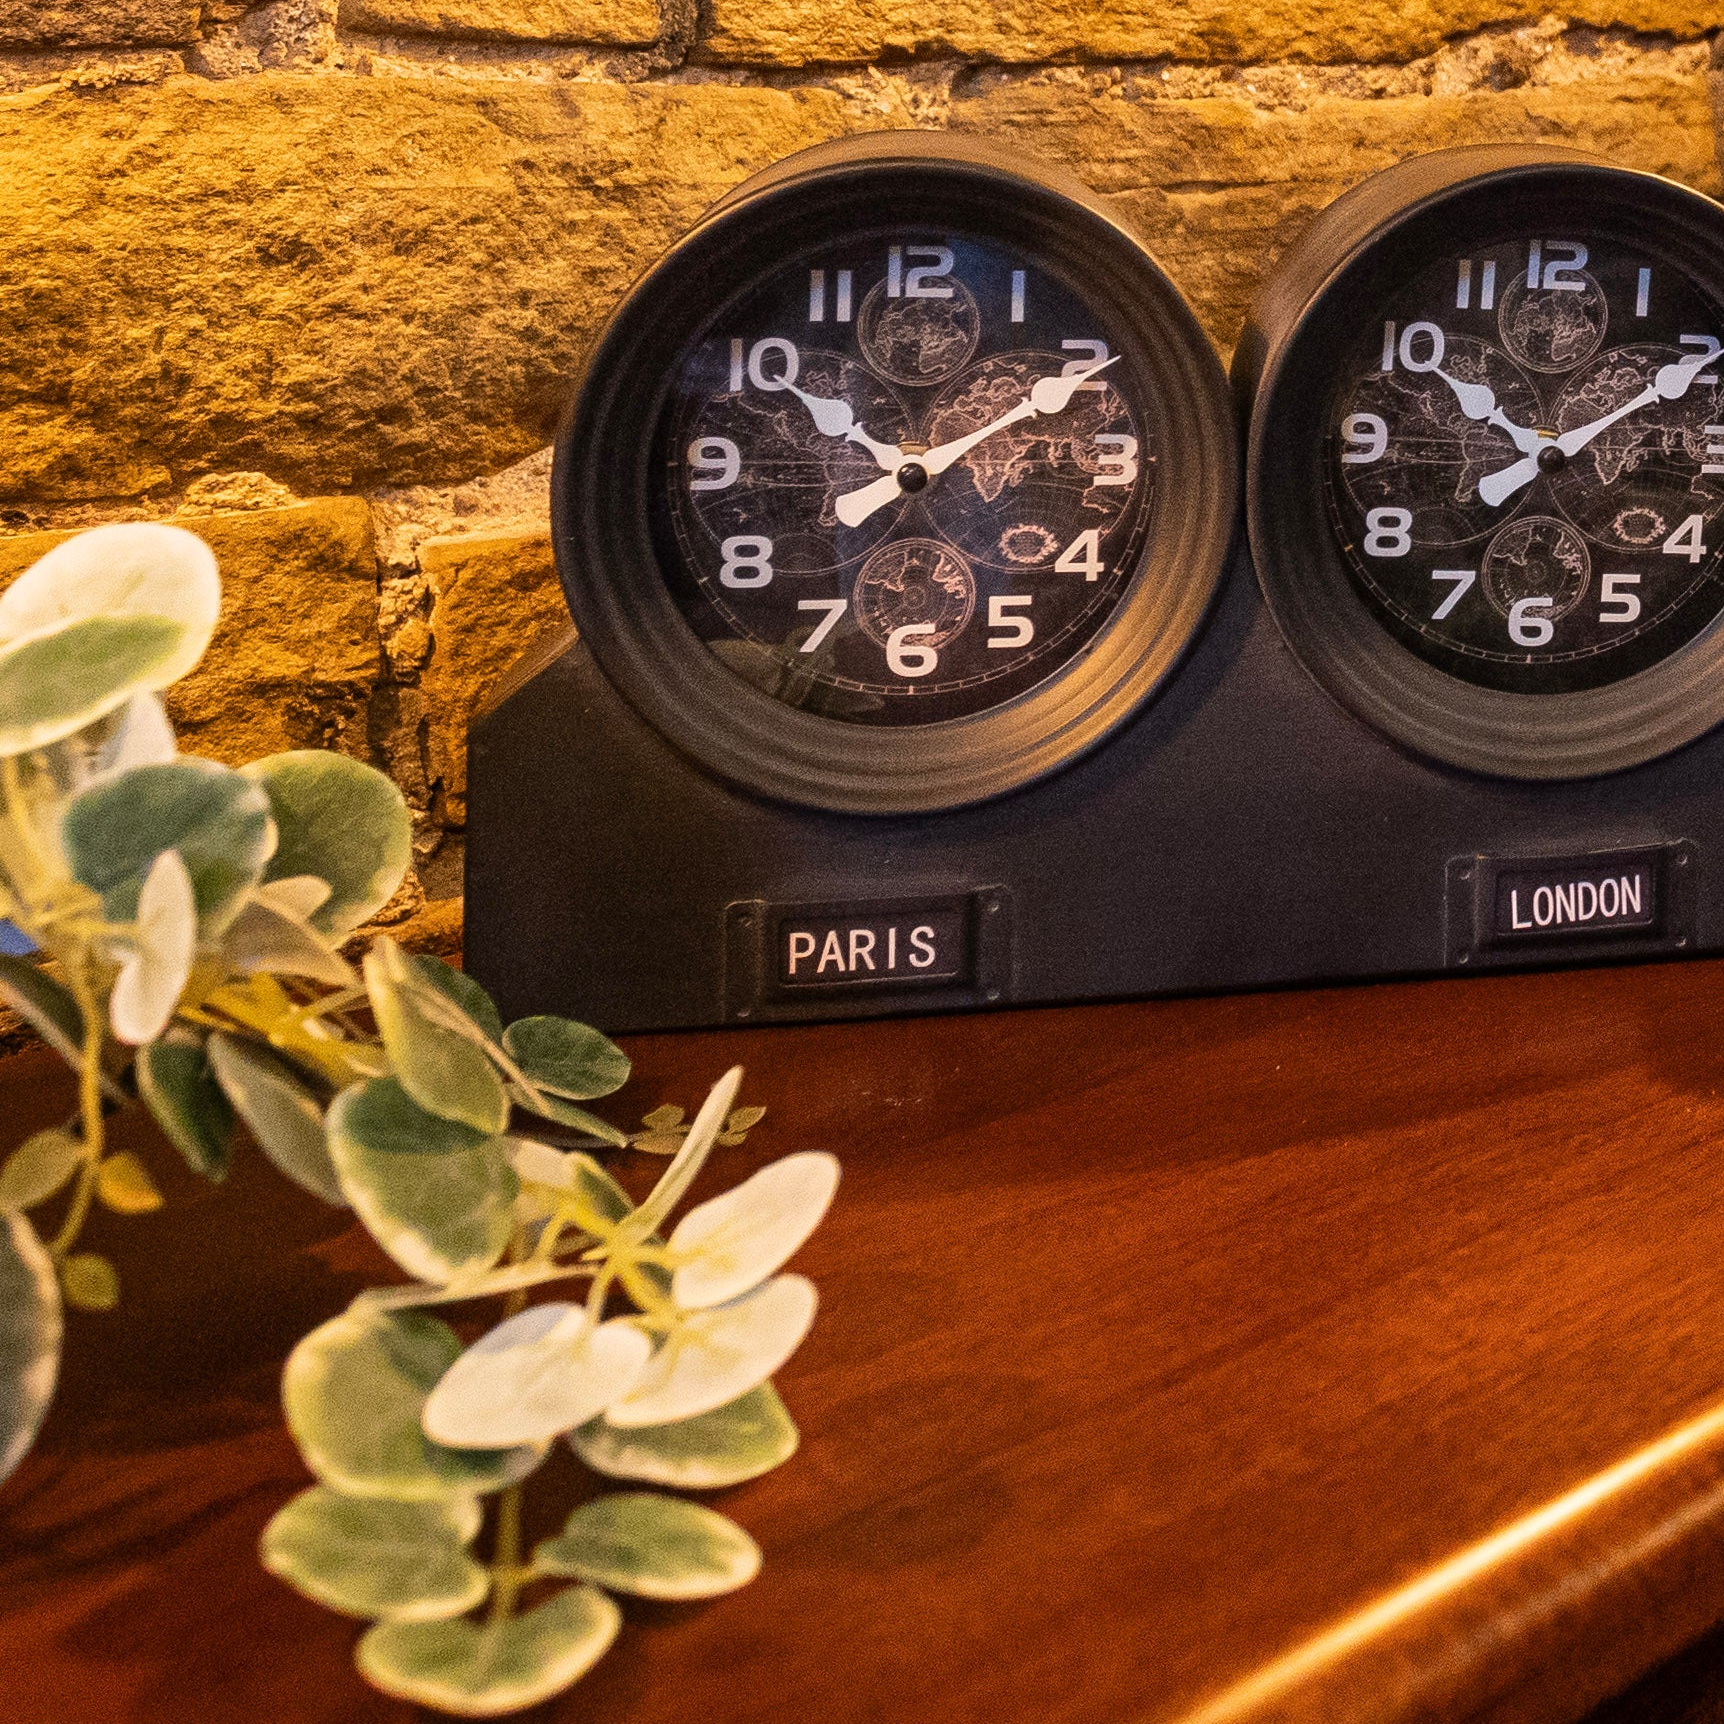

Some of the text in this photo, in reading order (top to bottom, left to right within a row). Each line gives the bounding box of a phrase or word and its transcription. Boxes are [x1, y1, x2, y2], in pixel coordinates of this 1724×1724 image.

[888, 246, 954, 298] 12
[1456, 259, 1495, 310] 11
[1527, 240, 1588, 291] 12
[809, 269, 851, 322] 11
[1011, 270, 1026, 322] 1
[1636, 268, 1651, 316] 1
[729, 338, 799, 391] 10
[1061, 339, 1110, 391] 2
[1381, 321, 1444, 372] 10
[688, 437, 741, 490] 9
[1093, 434, 1138, 486] 3
[1341, 414, 1388, 463] 9
[1054, 529, 1104, 581] 4
[1363, 507, 1412, 557] 8
[1662, 515, 1706, 563] 4
[720, 536, 773, 588] 8
[1431, 570, 1476, 619] 7
[1599, 574, 1641, 622] 5
[798, 599, 847, 652] 7
[987, 595, 1034, 648] 5
[1507, 597, 1554, 646] 6
[886, 624, 937, 677] 6
[1511, 874, 1641, 930] LONDON
[788, 926, 936, 975] PARIS
